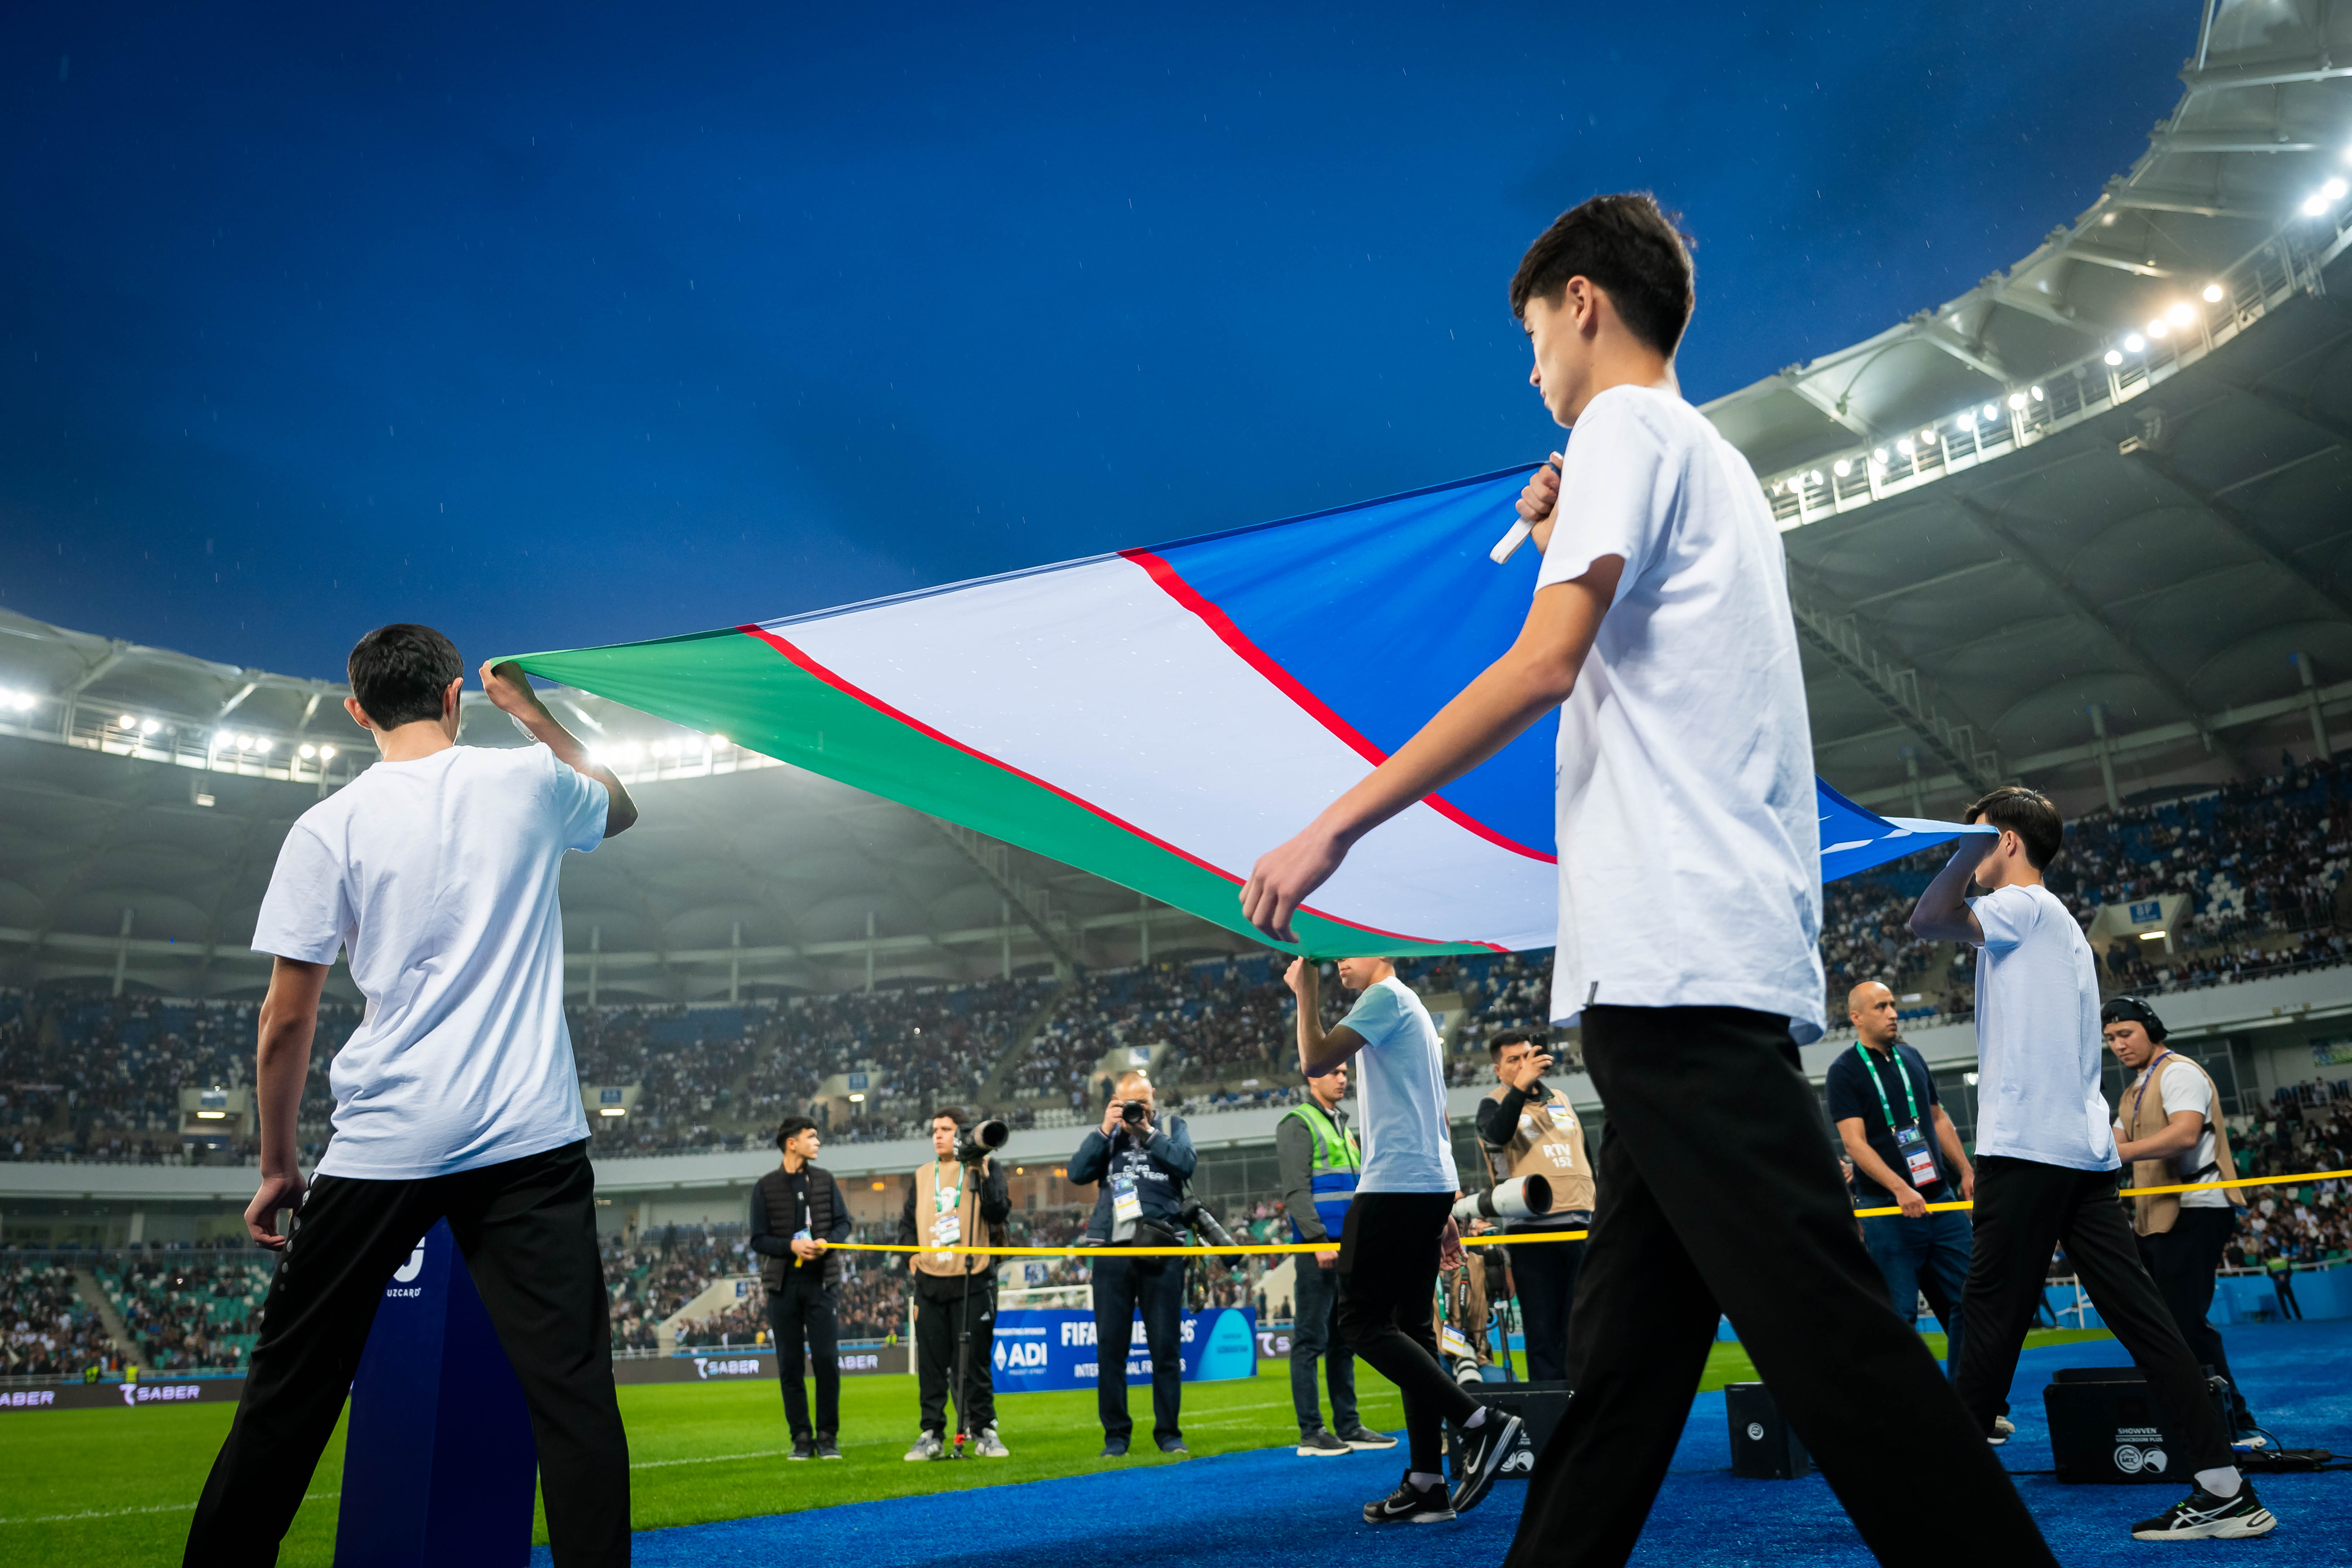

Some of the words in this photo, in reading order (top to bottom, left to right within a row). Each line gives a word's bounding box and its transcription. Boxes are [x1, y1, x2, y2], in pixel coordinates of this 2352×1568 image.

[1543, 1144, 1570, 1158] RTV
[1553, 1157, 1573, 1168] 152
[387, 1288, 420, 1298] UZCARD
[1061, 1321, 1098, 1347] FIFA
[1008, 1342, 1047, 1367] ADI
[708, 1359, 759, 1375] SABER
[838, 1355, 878, 1370] ABER
[0, 1391, 55, 1406] ABER
[136, 1385, 201, 1401] SABER
